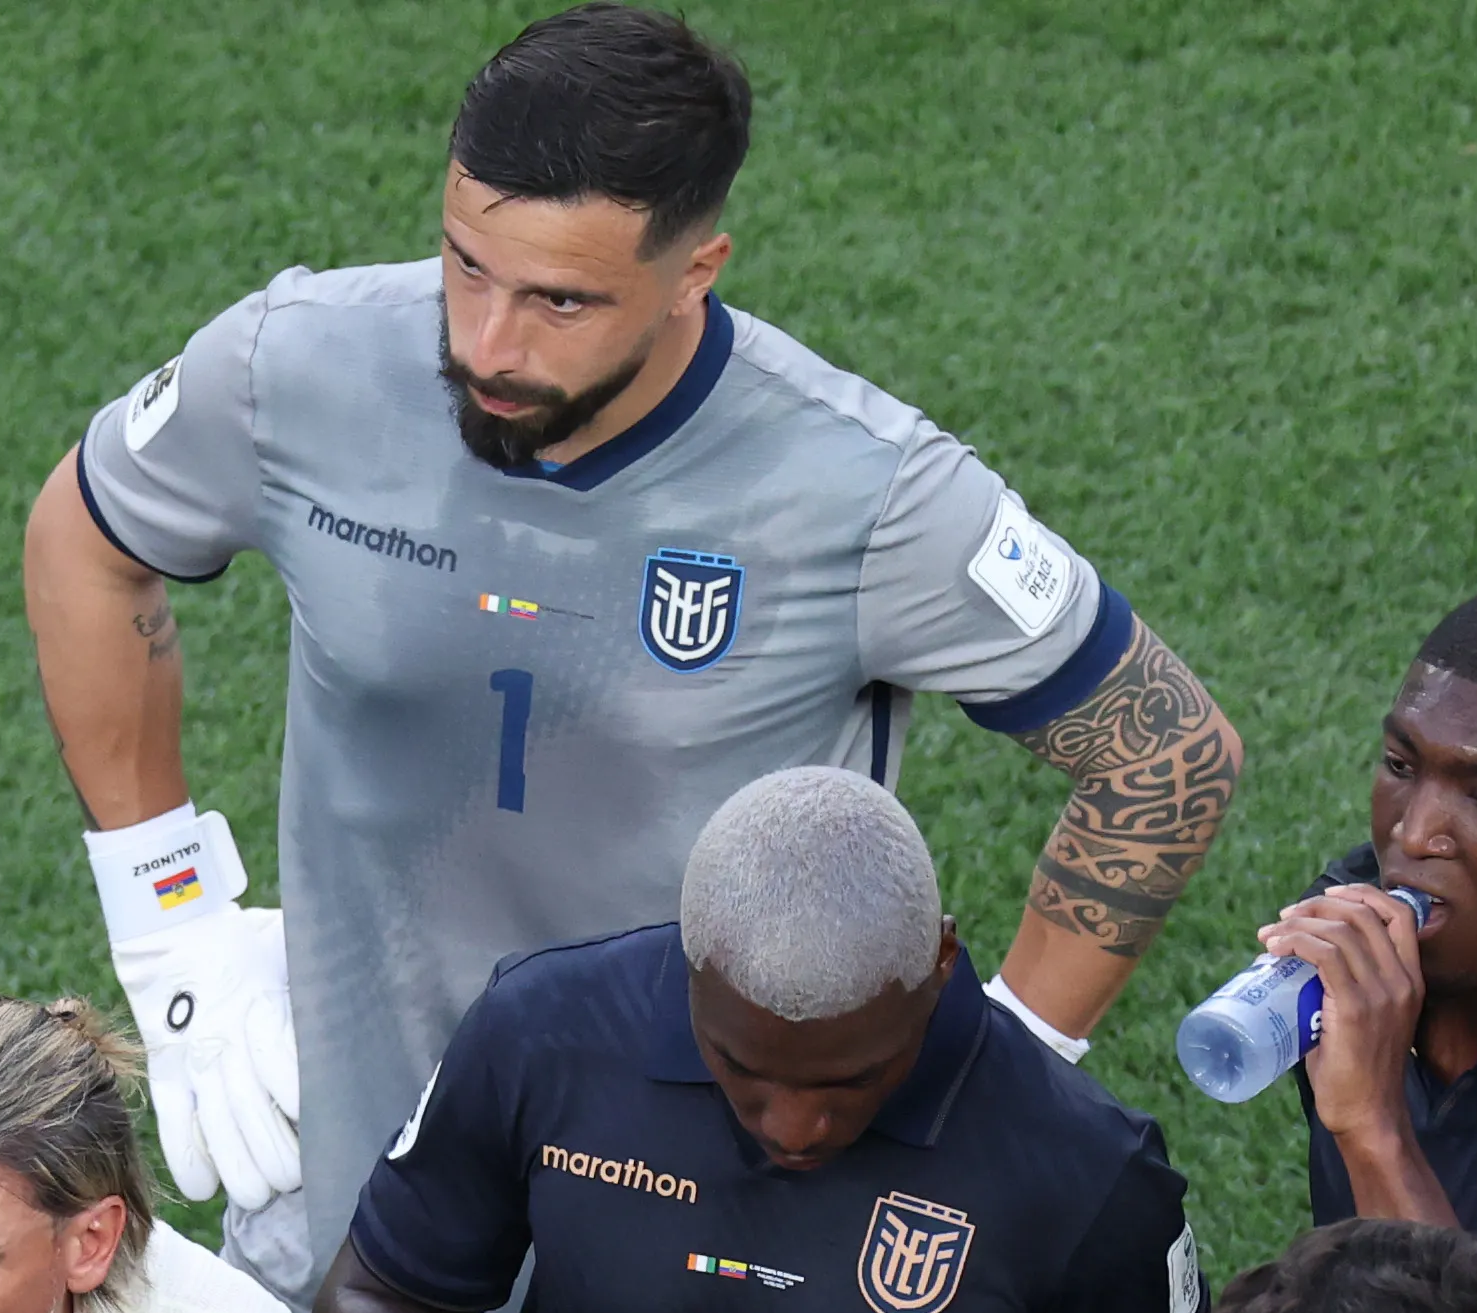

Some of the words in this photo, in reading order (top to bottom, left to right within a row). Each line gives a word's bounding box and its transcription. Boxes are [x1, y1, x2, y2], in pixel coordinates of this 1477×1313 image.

[308, 503, 458, 573] marathon
[1028, 553, 1053, 600] PEACE
[489, 668, 534, 814] 1
[542, 1144, 698, 1204] marathon
